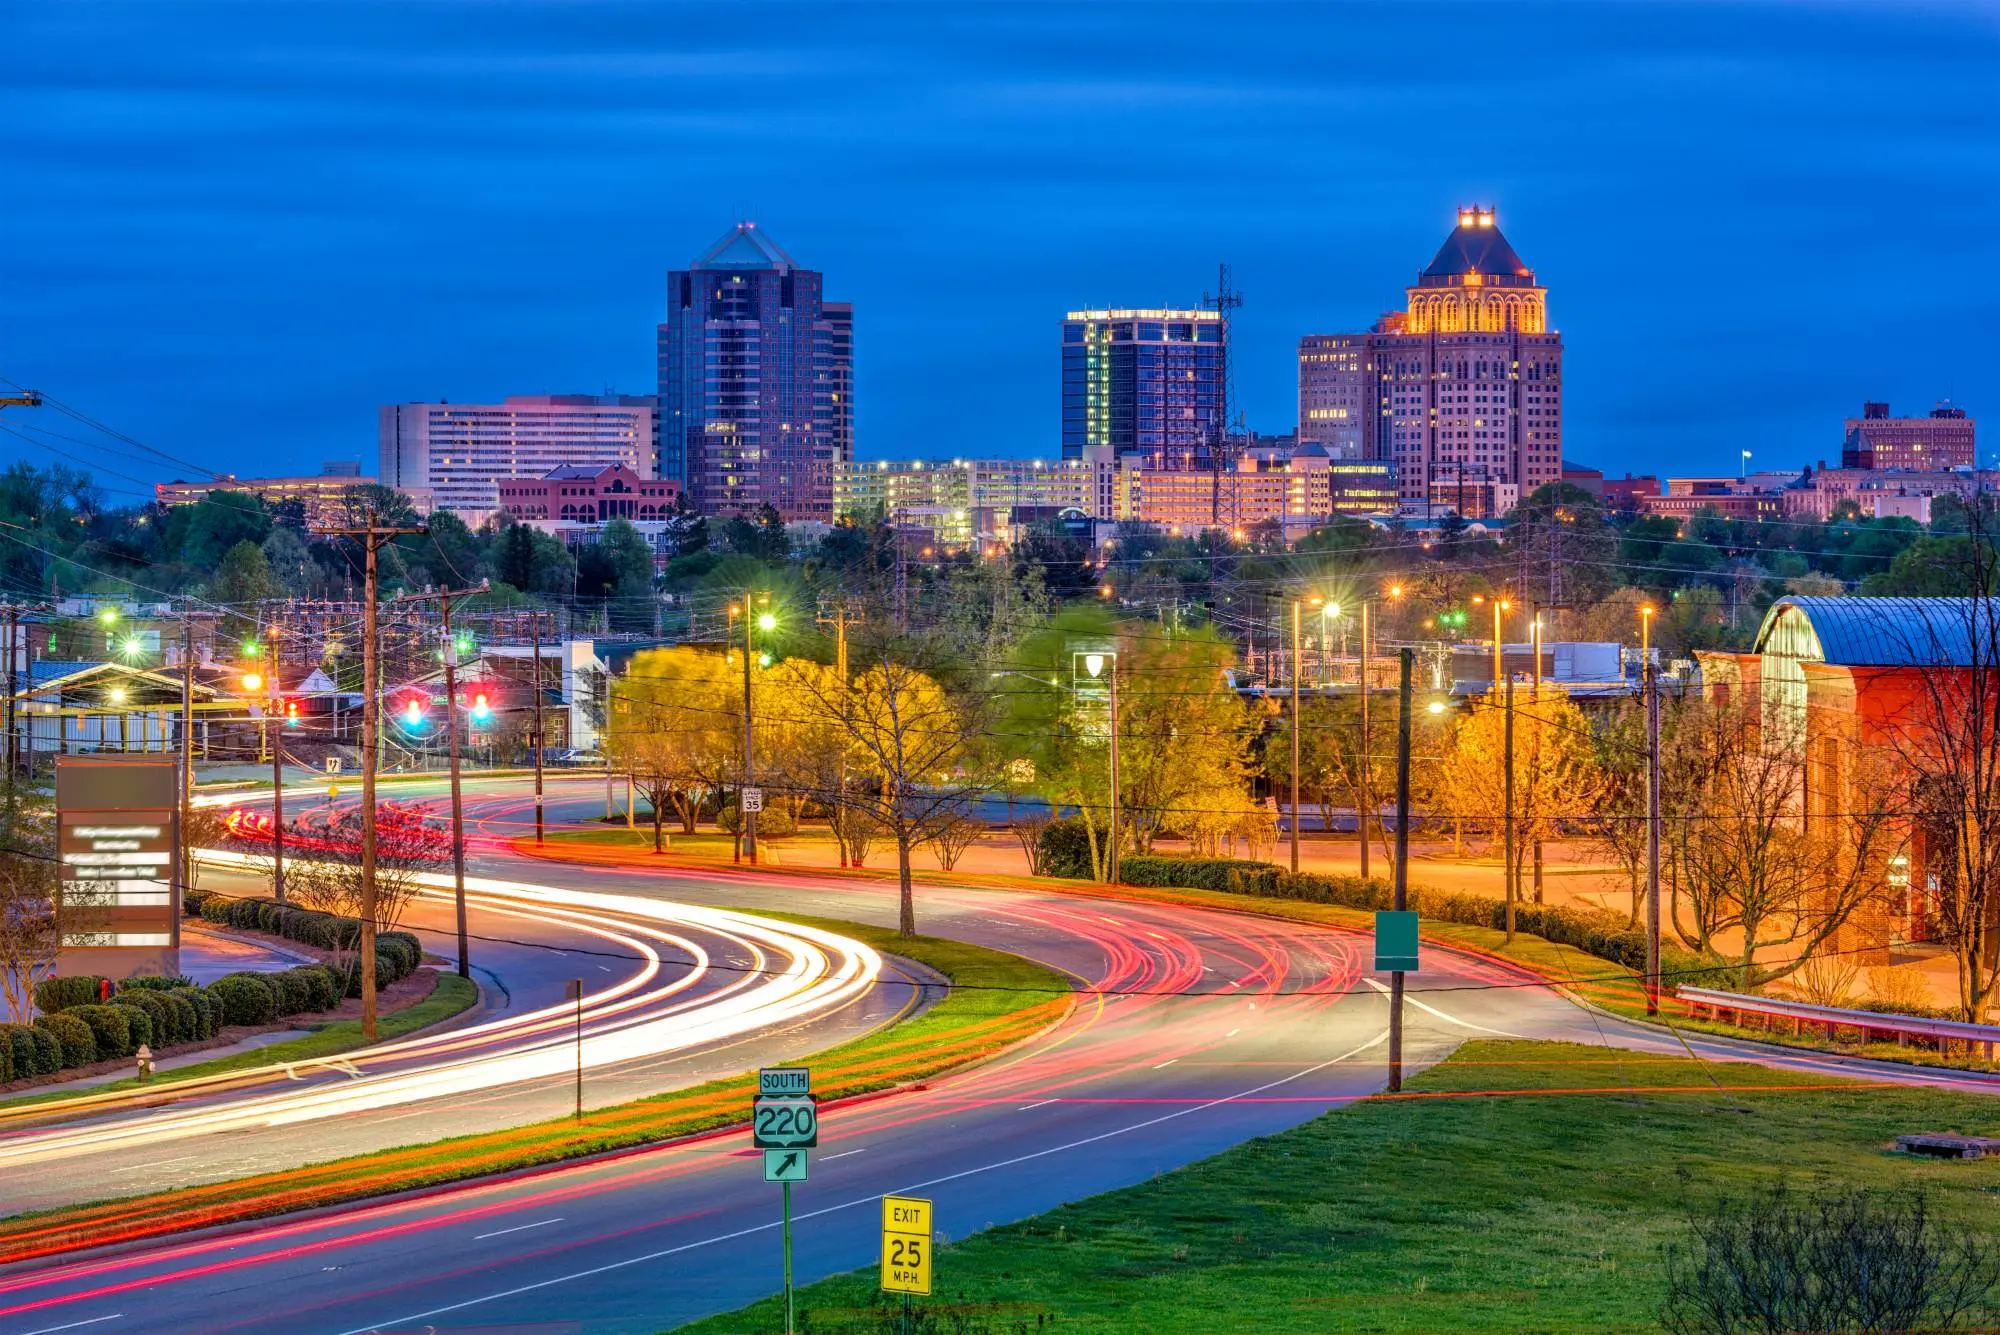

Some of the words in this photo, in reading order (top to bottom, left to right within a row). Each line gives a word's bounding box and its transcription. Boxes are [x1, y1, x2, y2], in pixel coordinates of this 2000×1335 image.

[746, 800, 760, 810] 35
[762, 1073, 806, 1089] SOUTH
[758, 1106, 813, 1136] 220
[893, 1207, 921, 1224] EXIT
[890, 1239, 921, 1268] 25
